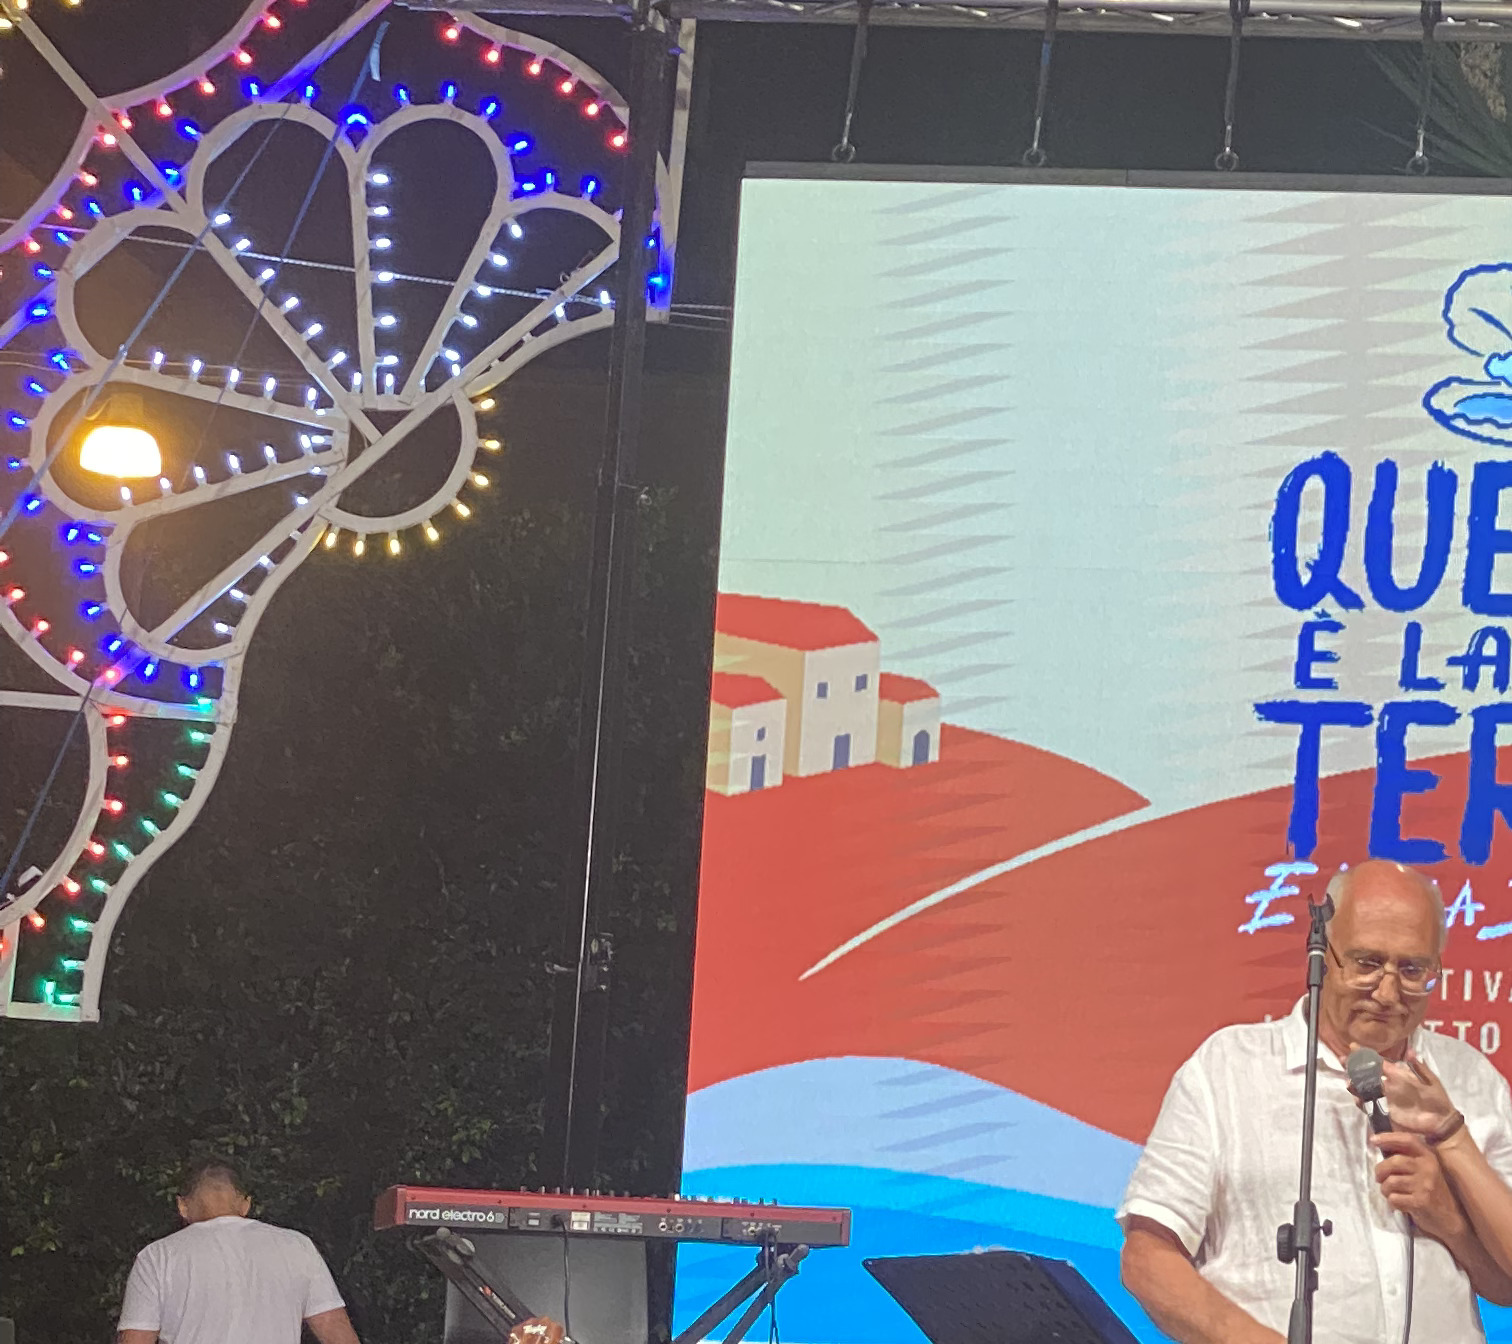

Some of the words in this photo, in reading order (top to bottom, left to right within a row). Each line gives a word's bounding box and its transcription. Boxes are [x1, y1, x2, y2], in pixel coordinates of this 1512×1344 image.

[1400, 621, 1512, 691] LA
[1238, 861, 1319, 934] E
[408, 1208, 440, 1220] nord
